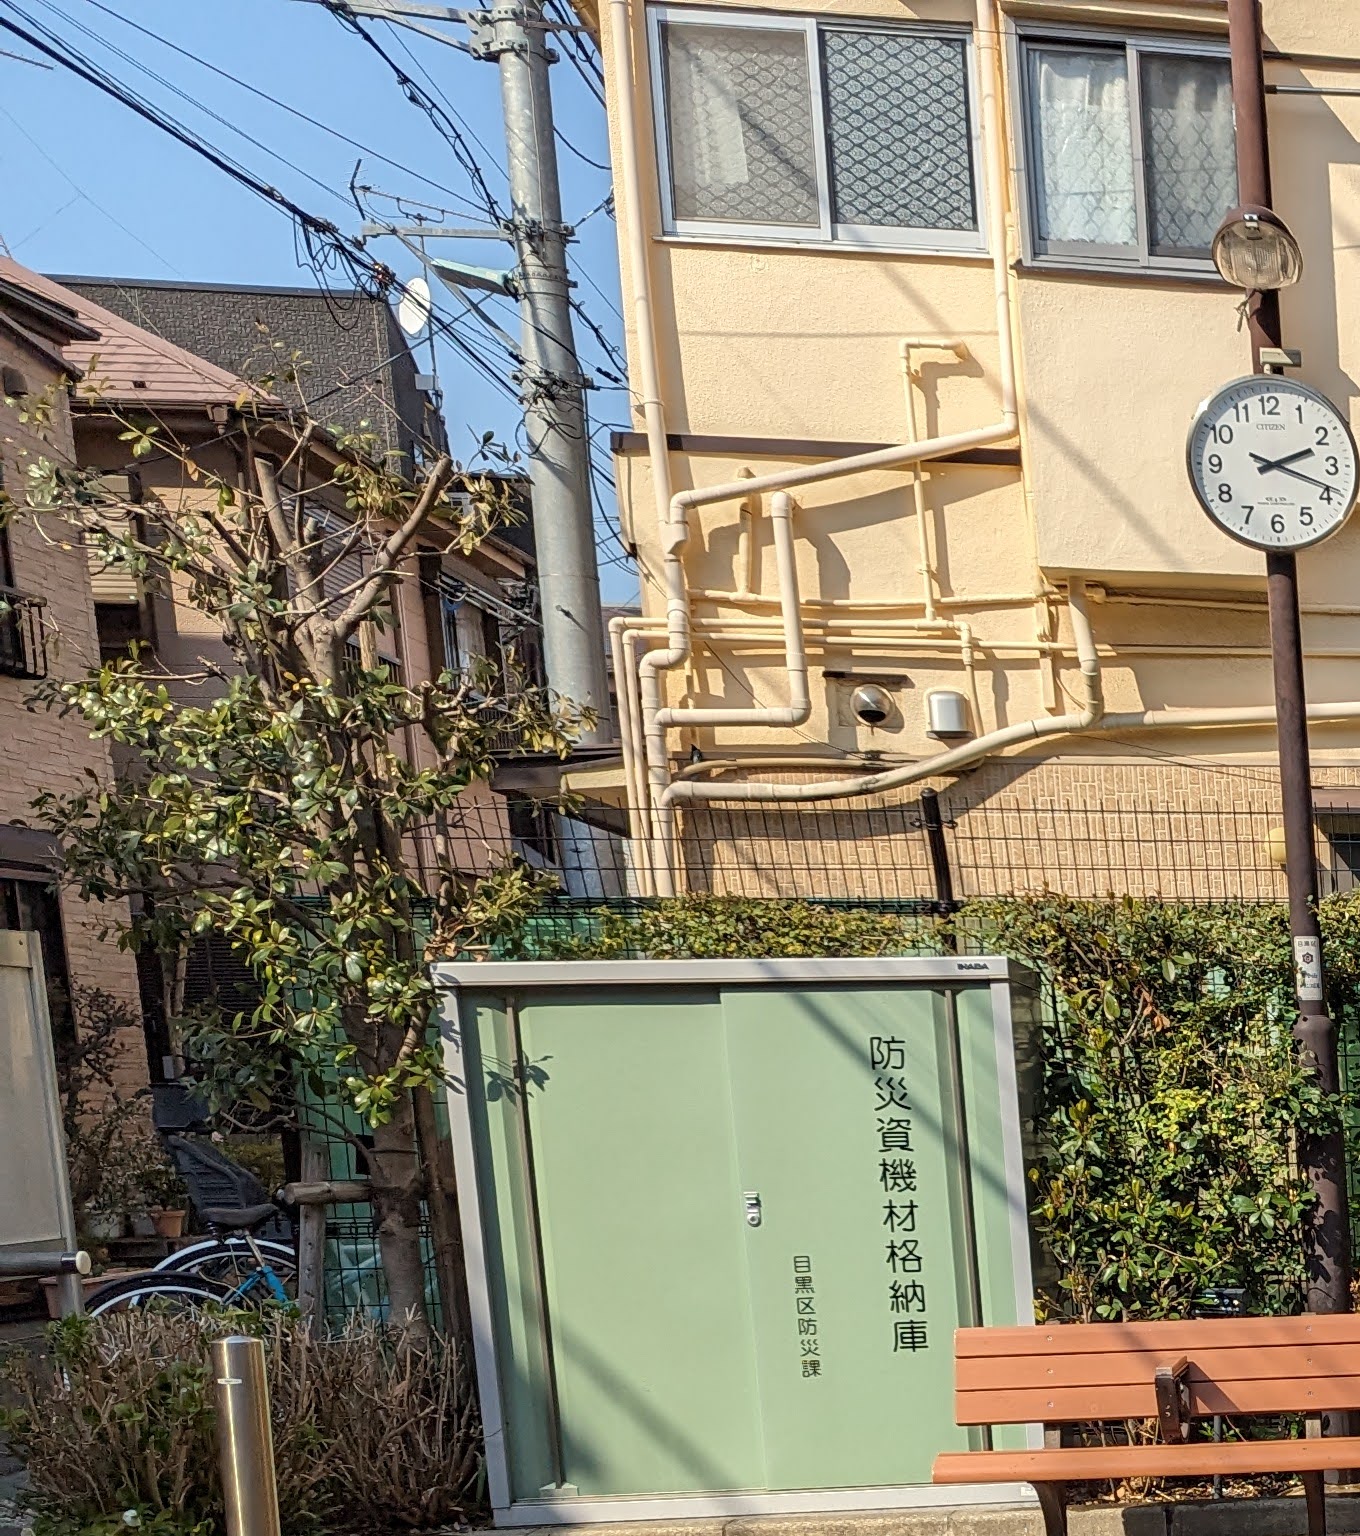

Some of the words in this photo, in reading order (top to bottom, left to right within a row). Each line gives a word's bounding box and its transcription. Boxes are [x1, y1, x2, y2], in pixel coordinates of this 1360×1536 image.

[1233, 403, 1249, 422] 11
[1258, 395, 1280, 416] 12
[1295, 404, 1303, 424] 1
[1210, 424, 1233, 444] 10
[1256, 423, 1286, 431] CITIZEN
[1315, 426, 1329, 446] 2
[1208, 454, 1223, 474] 9
[1325, 456, 1339, 476] 3
[1218, 483, 1232, 503] 8
[1319, 486, 1333, 505] 4
[1241, 505, 1254, 525] 7
[1271, 514, 1285, 533] 6
[1300, 507, 1313, 526] 5
[869, 1034, 930, 1355] 防災資機材格納庫
[792, 1254, 823, 1380] 目黒区防災課
